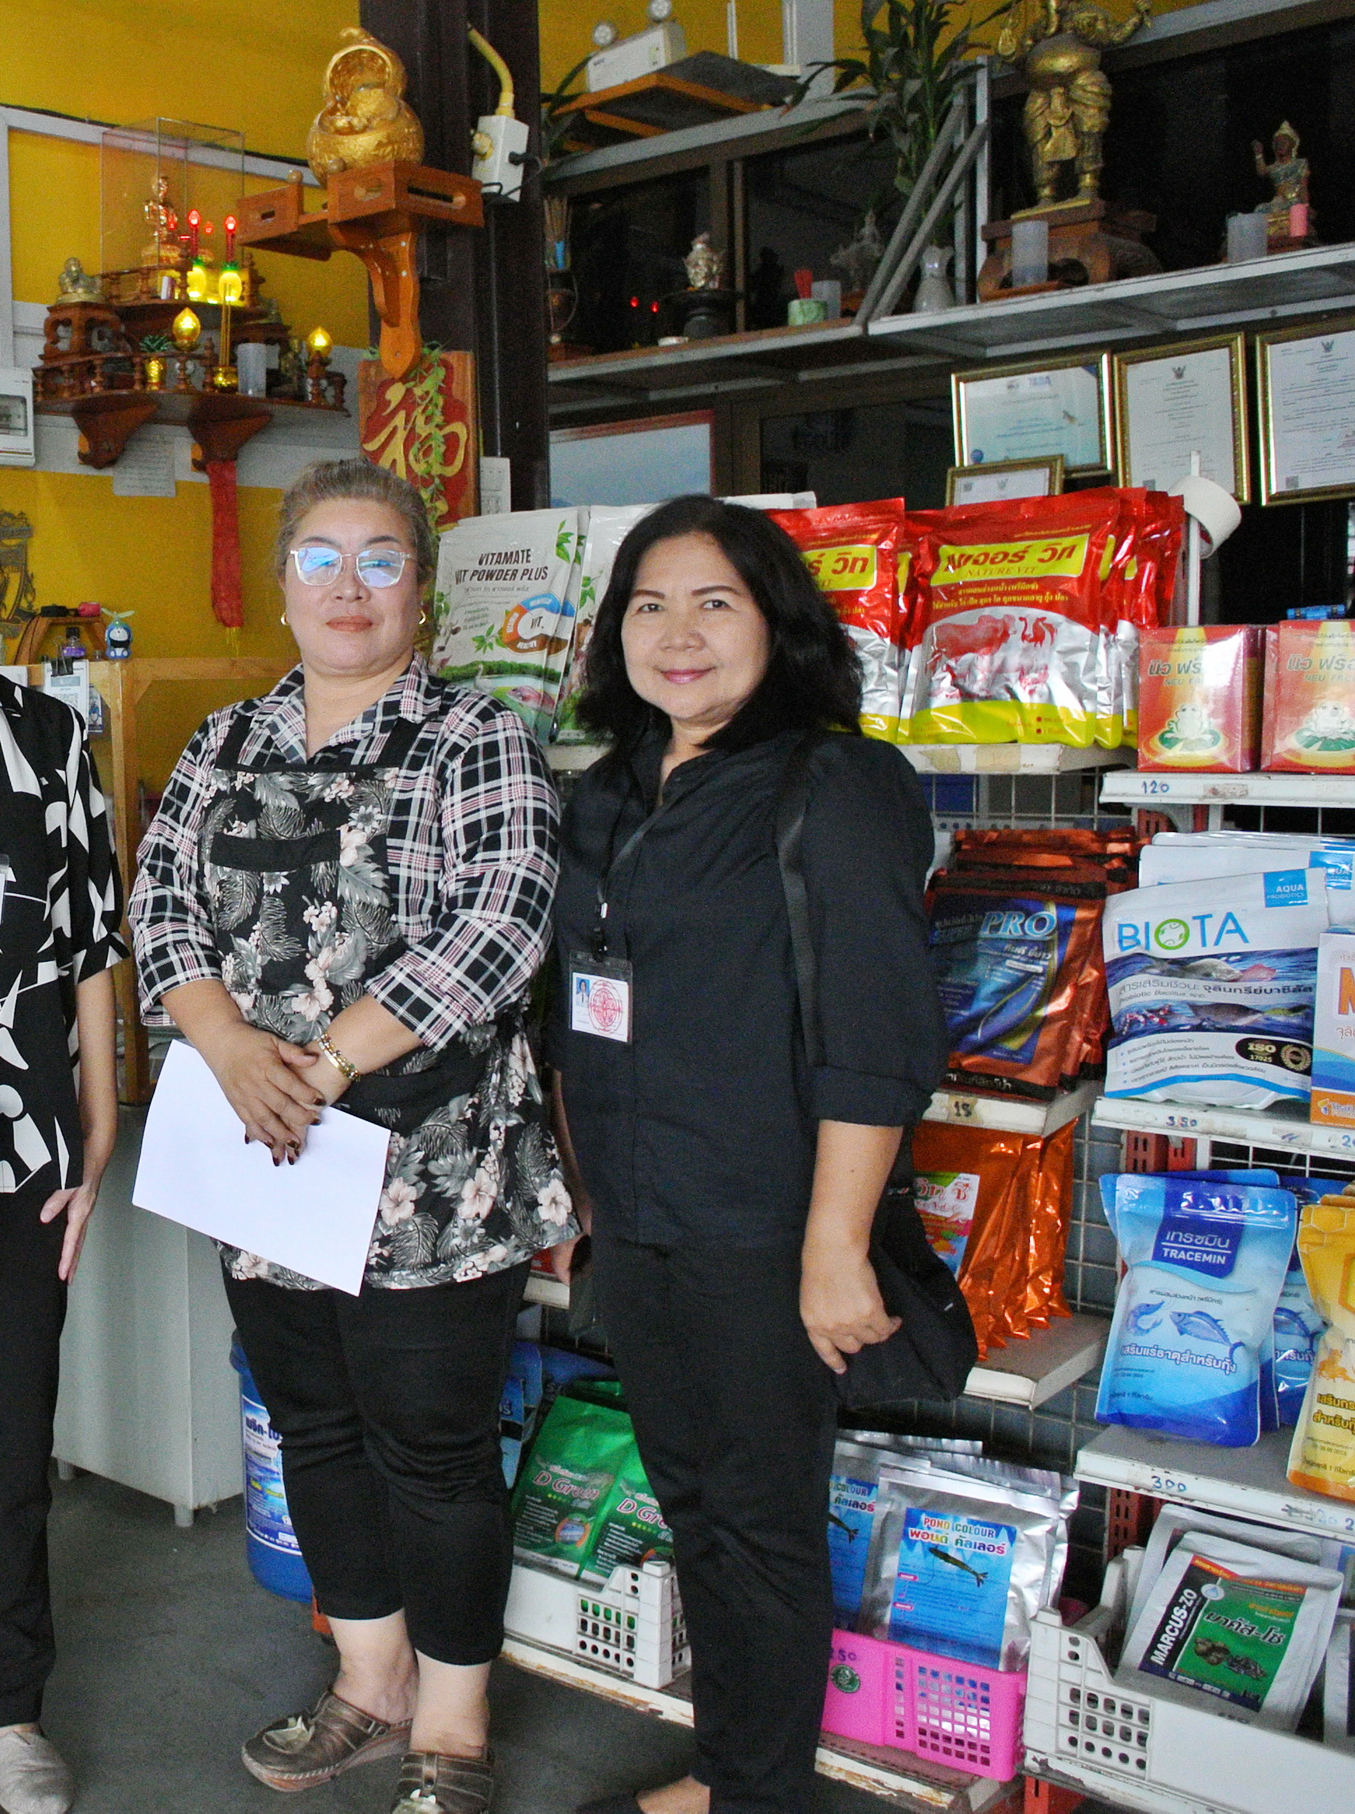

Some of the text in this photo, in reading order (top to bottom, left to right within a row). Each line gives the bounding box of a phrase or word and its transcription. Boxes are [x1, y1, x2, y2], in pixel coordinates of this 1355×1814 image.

[478, 549, 531, 566] VITAMATE
[455, 566, 549, 585] VIT POWDER PLUS
[1142, 781, 1170, 794] 120
[1267, 892, 1305, 900] PROBIOTICS
[1276, 884, 1304, 893] AQUA
[979, 910, 1057, 937] PRO
[1118, 912, 1250, 951] BIOTA
[1247, 1042, 1276, 1054] ISO
[1162, 1247, 1226, 1265] TRACEMIN
[533, 1470, 552, 1486] D
[1151, 1475, 1187, 1493] 300
[836, 1483, 869, 1496] COLOUR
[616, 1497, 637, 1514] D
[923, 1516, 996, 1538] POND COLOUR
[909, 1528, 1005, 1555] พอนด์ คัลเลอร์
[1150, 1588, 1198, 1666] MARCUS-ZO
